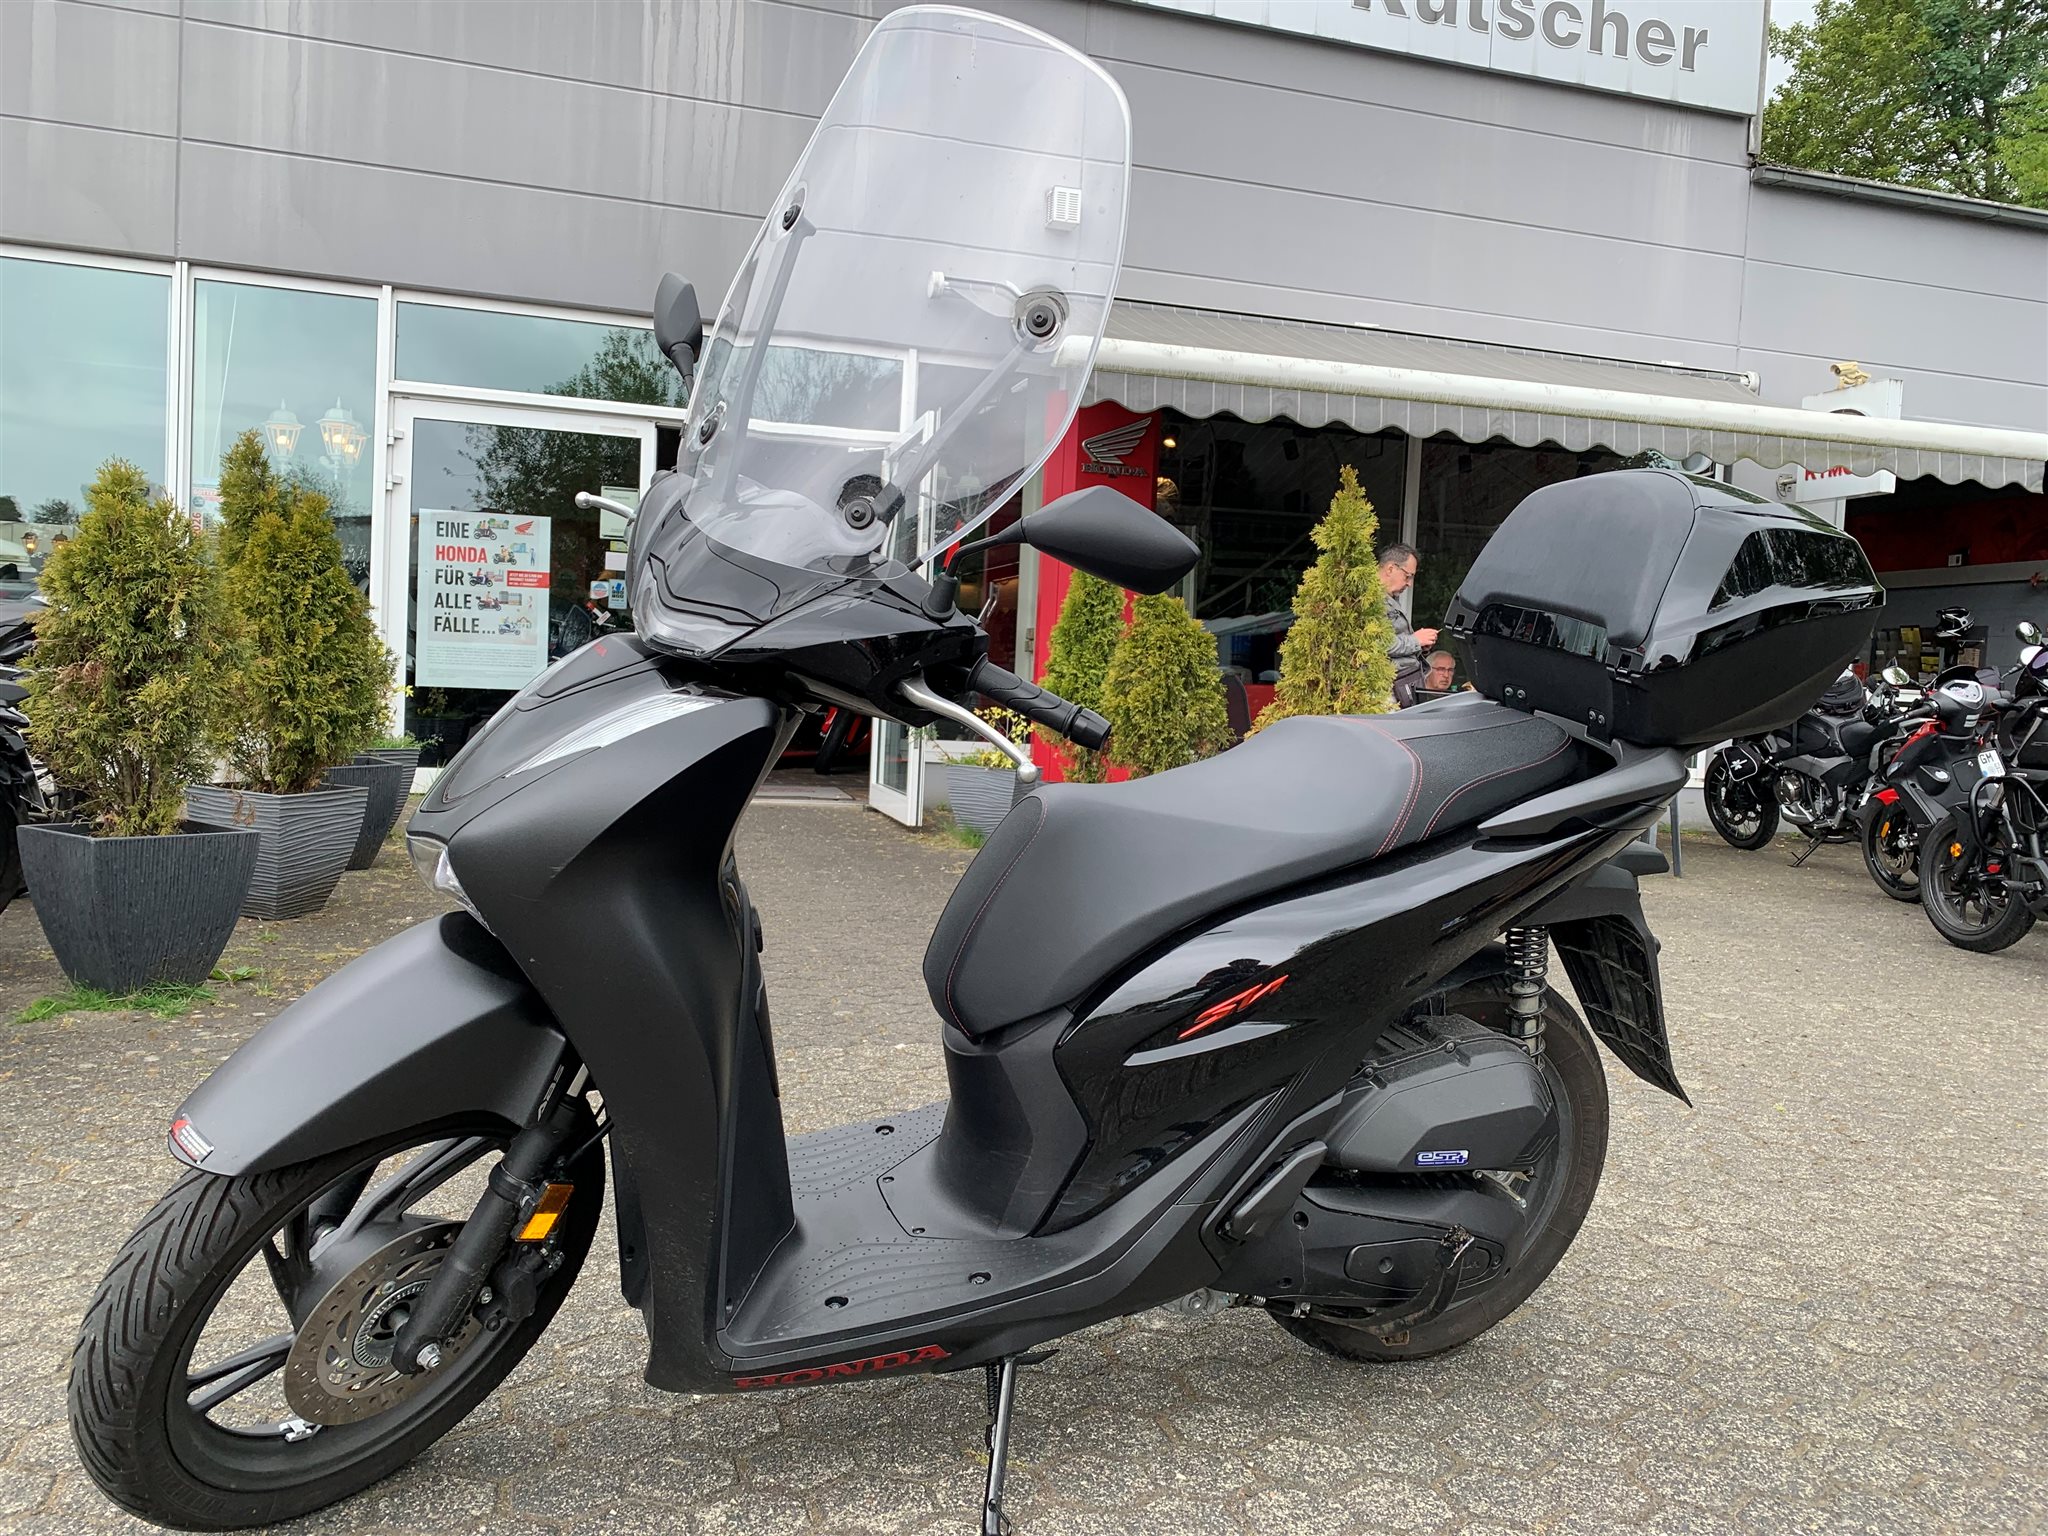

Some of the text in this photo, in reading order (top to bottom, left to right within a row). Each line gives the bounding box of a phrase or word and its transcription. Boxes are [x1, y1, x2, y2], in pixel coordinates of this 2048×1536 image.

[1351, 0, 1709, 71] utscher
[1081, 463, 1147, 477] HONDA
[436, 521, 470, 539] EINE
[435, 545, 488, 563] HONDA
[435, 565, 465, 586] FÜR
[434, 592, 472, 609] ALLE
[733, 1344, 952, 1389] HONDA
